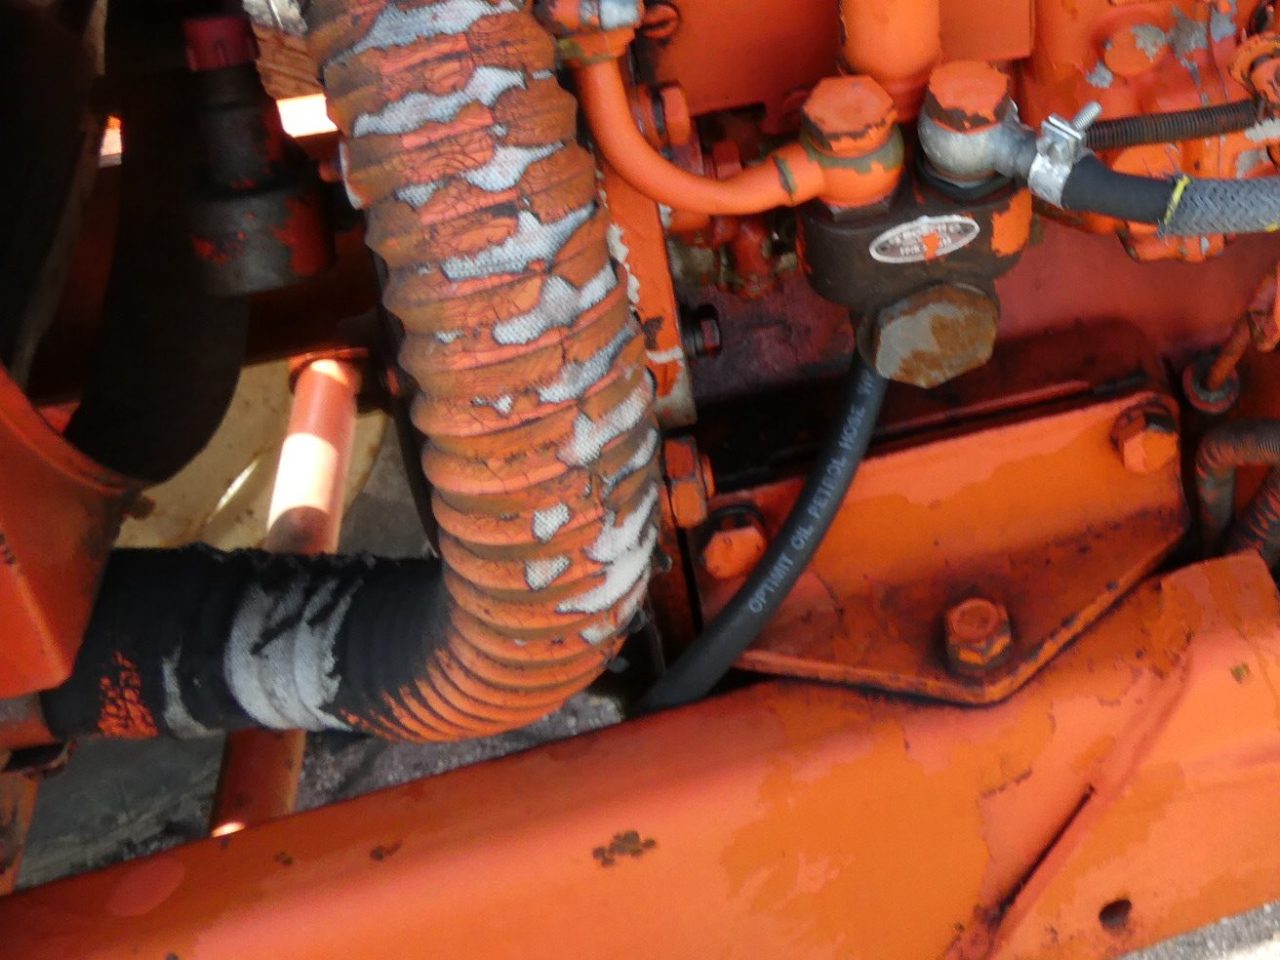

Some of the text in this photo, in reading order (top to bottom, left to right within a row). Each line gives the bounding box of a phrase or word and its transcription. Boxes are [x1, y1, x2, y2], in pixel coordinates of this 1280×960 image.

[749, 552, 794, 613] OPTIMIT
[790, 525, 814, 551] OIL
[808, 455, 847, 519] PETROL
[838, 404, 866, 450] HOSE
